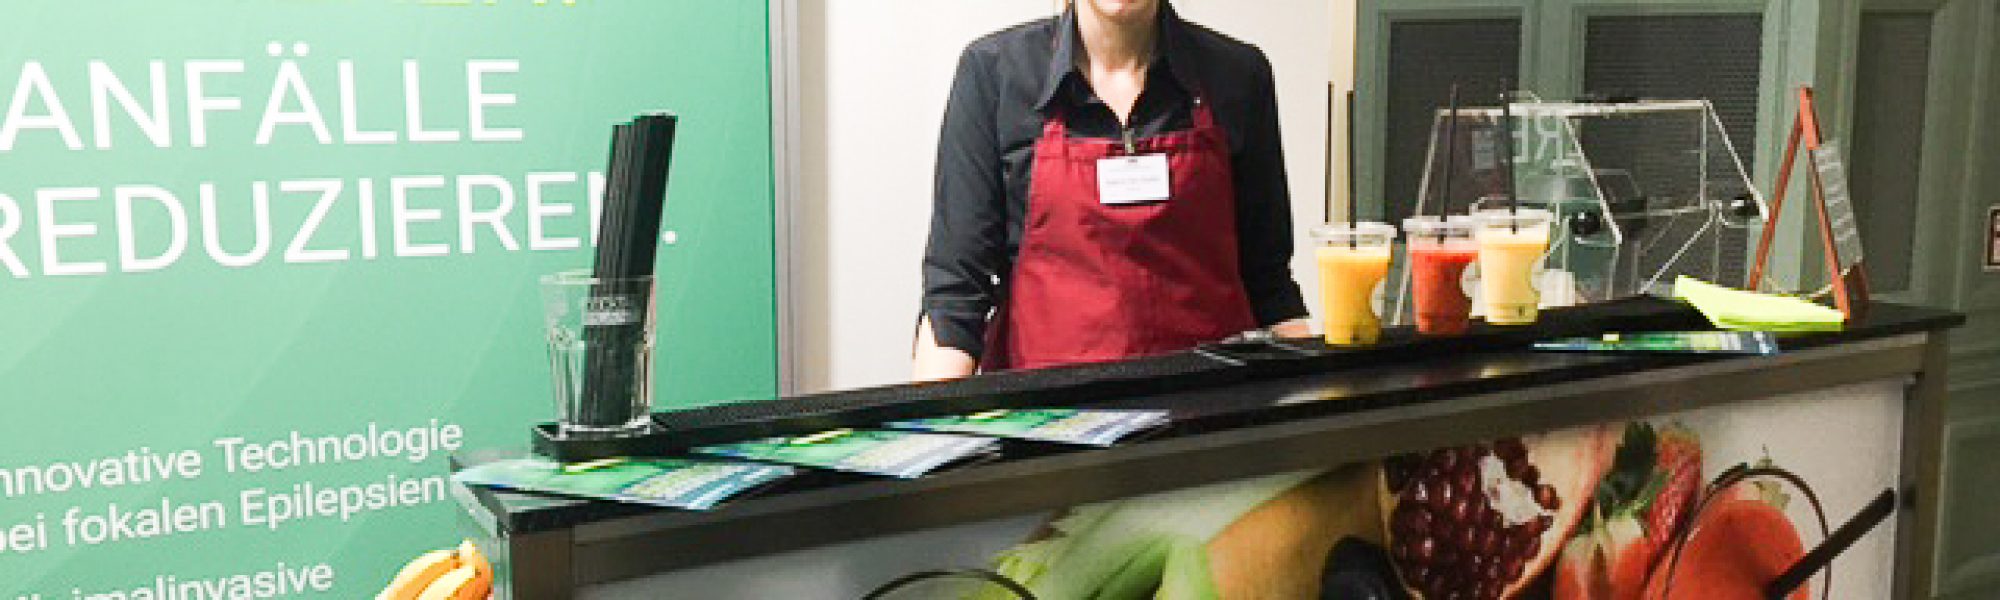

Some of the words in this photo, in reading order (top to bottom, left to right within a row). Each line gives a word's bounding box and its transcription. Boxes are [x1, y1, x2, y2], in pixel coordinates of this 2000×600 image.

[0, 41, 524, 150] ANFÄLLE
[0, 172, 678, 278] EDUZIERE.
[214, 419, 463, 472] Technologie
[0, 513, 48, 552] ei
[62, 498, 225, 545] fokalen
[240, 474, 444, 530] Epilepsien
